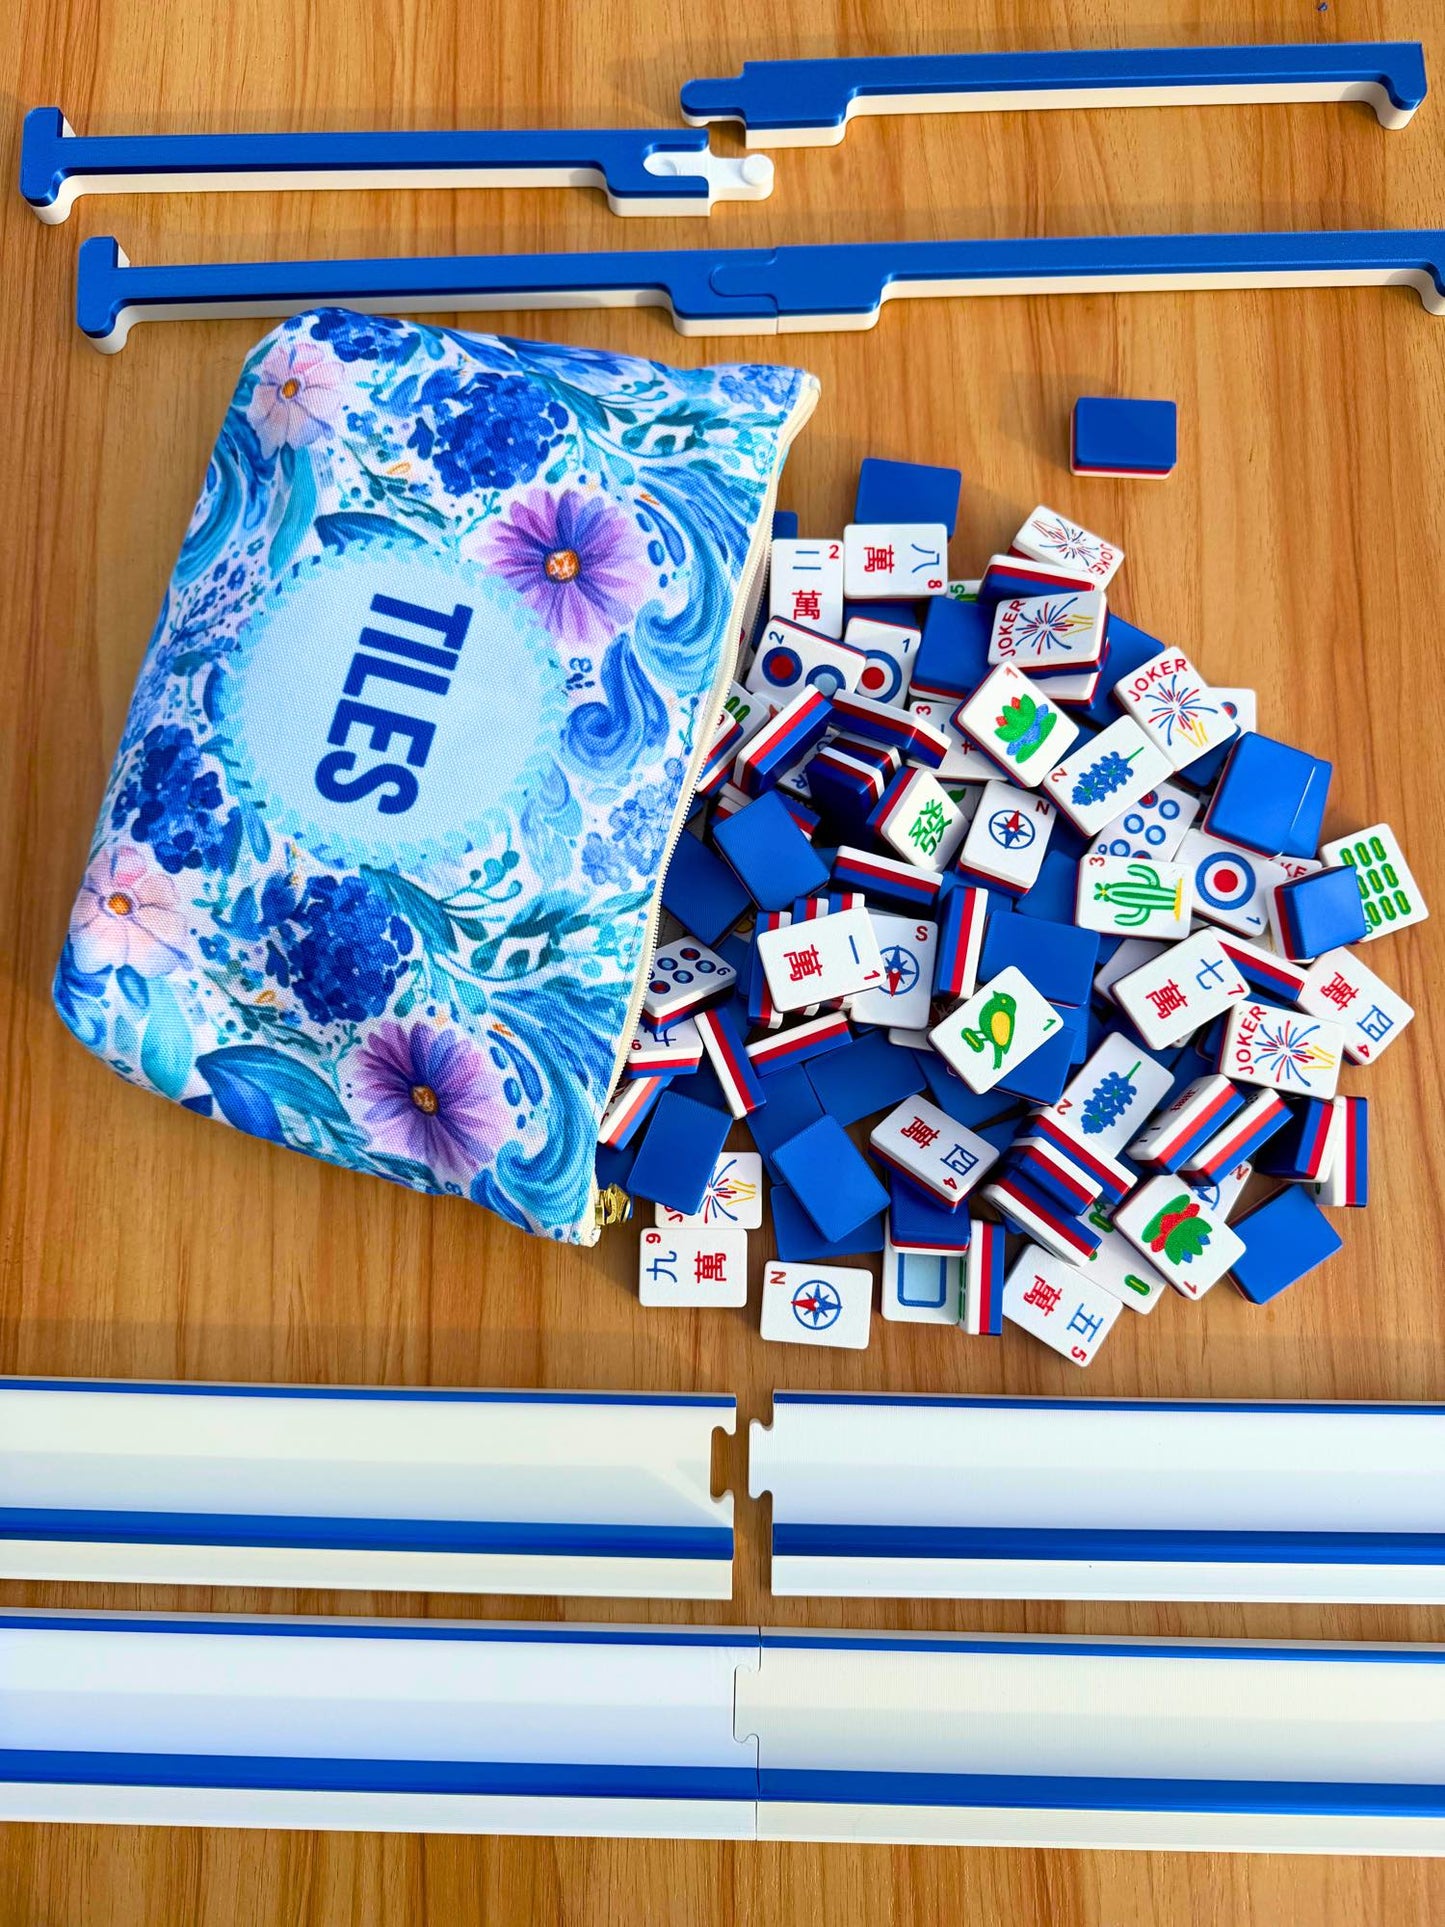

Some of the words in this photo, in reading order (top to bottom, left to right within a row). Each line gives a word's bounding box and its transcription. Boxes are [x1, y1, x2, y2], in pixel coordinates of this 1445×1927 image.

[829, 545, 839, 559] 2
[1088, 543, 1113, 575] JOKE
[927, 579, 943, 589] 8
[950, 584, 965, 594] 5
[998, 600, 1026, 657] JOKER
[769, 631, 784, 644] 2
[902, 638, 910, 653] 1
[1003, 666, 1019, 679] 1
[1128, 658, 1188, 702] JOKER
[314, 593, 474, 815] TILES
[916, 706, 931, 715] 3
[1051, 768, 1068, 782] 2
[1035, 800, 1050, 815] N
[1089, 857, 1105, 867] 3
[1246, 916, 1262, 926] 1
[915, 926, 928, 942] S
[864, 970, 881, 980] 1
[1227, 984, 1245, 996] 7
[1043, 1019, 1056, 1031] 1
[1236, 1005, 1267, 1075] JOKER
[1357, 1044, 1370, 1058] 4
[1056, 1099, 1072, 1115] 2
[1230, 1164, 1249, 1180] N
[943, 1177, 958, 1190] 4
[646, 1233, 661, 1244] 9
[770, 1270, 787, 1285] N
[1184, 1281, 1197, 1294] 1
[1071, 1346, 1087, 1362] 5
